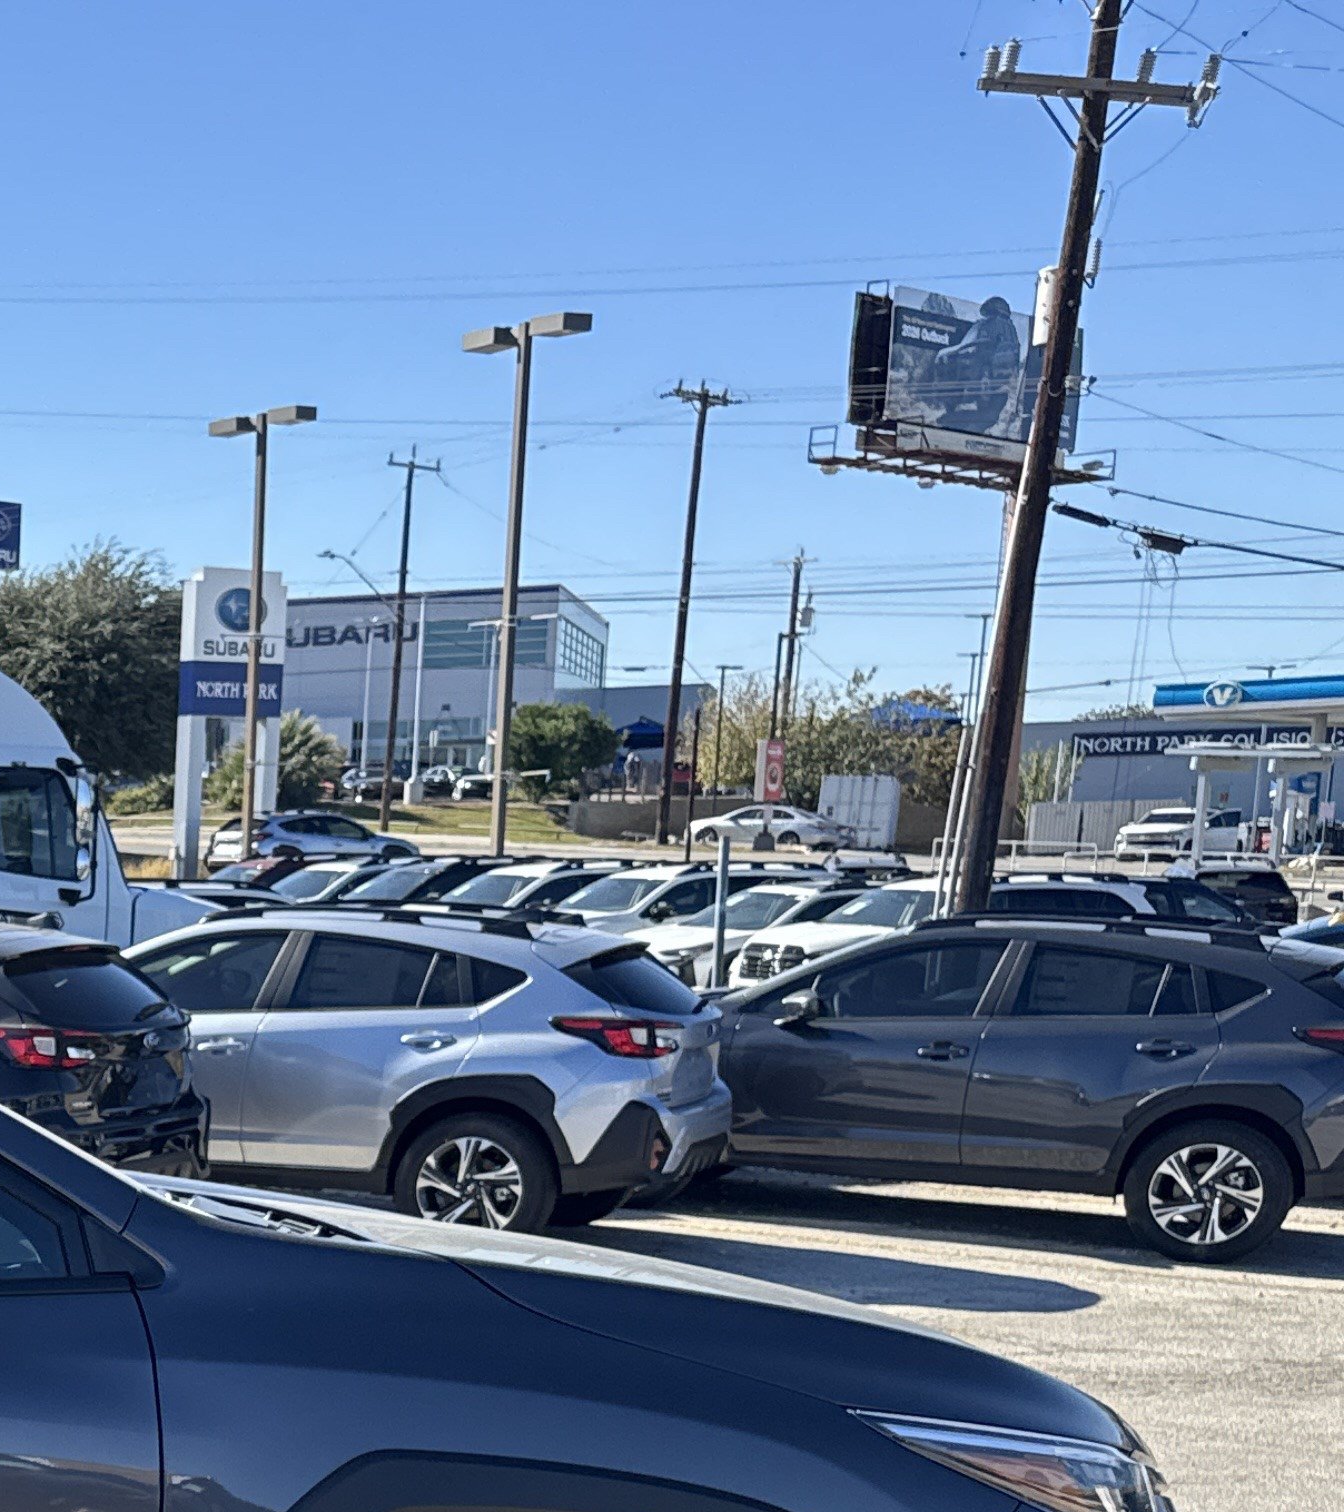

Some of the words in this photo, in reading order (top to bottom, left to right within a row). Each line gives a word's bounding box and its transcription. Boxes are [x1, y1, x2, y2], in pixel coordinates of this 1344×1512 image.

[285, 622, 419, 649] UBARU
[203, 639, 276, 658] SUBAU
[196, 681, 240, 699] NORTH
[242, 682, 278, 700] PRK
[1079, 736, 1151, 754] NORTH
